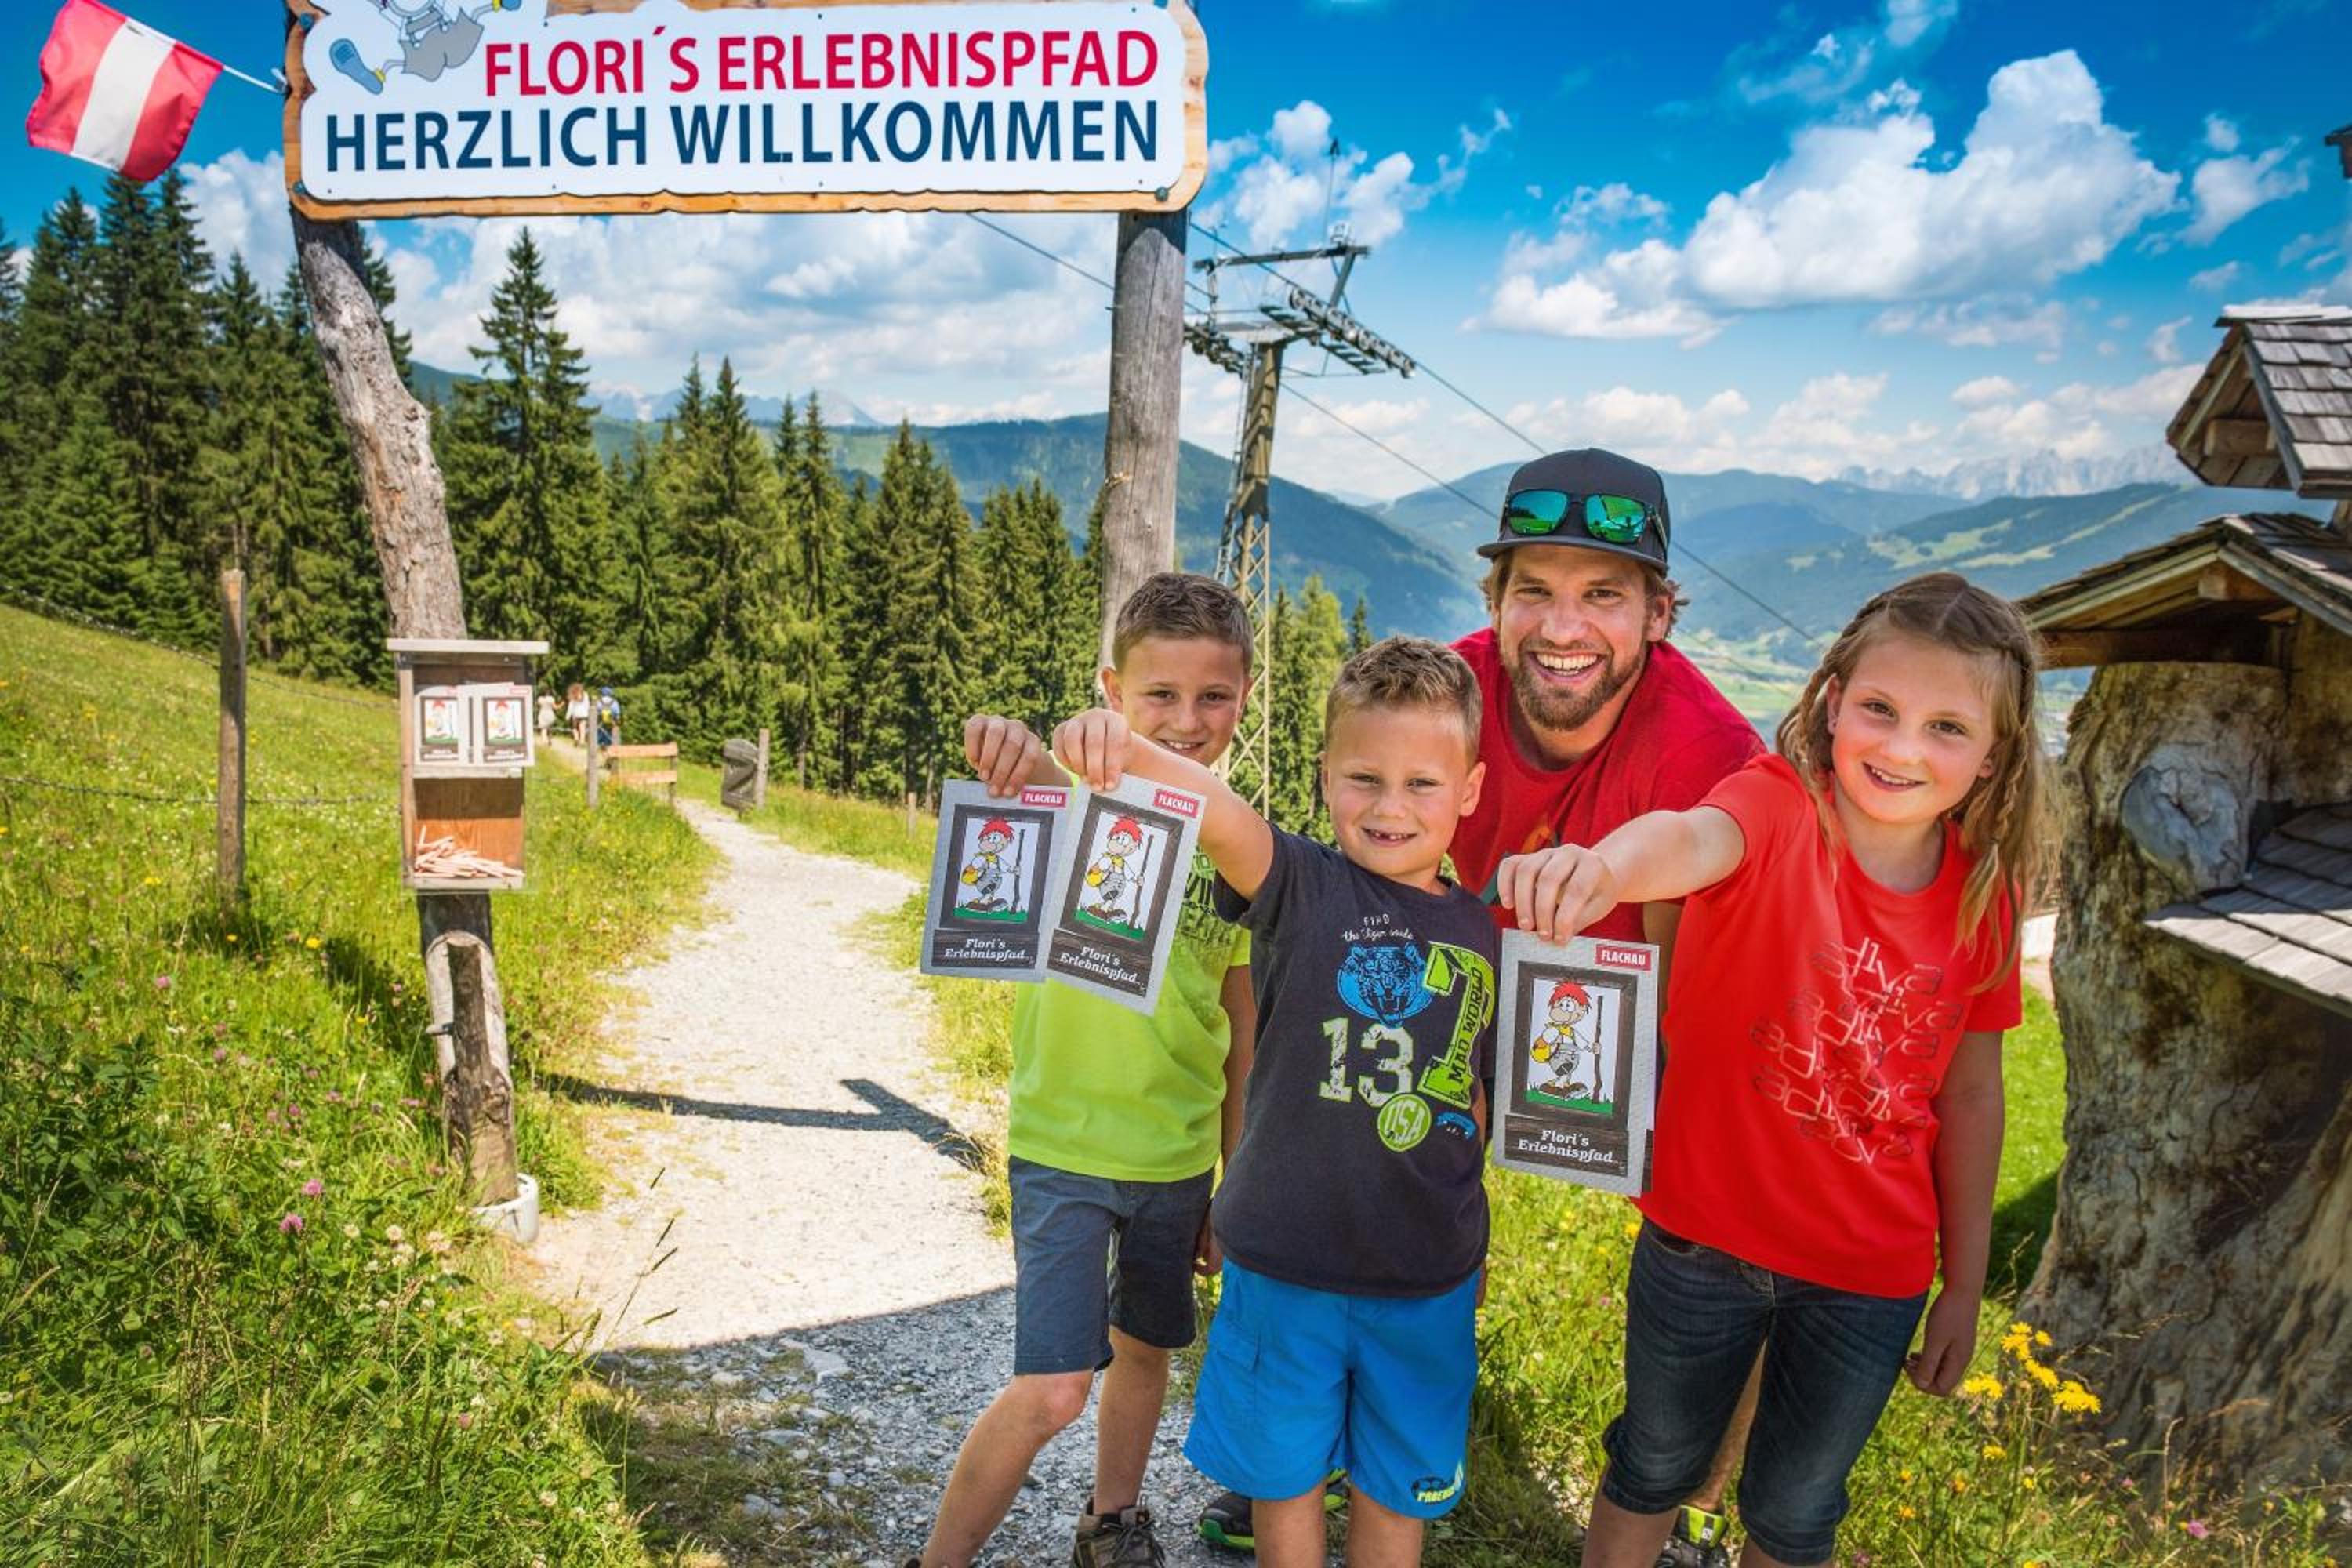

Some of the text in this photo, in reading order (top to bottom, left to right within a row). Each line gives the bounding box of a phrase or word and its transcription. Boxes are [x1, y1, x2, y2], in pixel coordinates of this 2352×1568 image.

[718, 31, 1158, 91] ERLEBNISPFAD
[327, 100, 1157, 172] HERZLICH WILLKOMMEN
[1602, 949, 1646, 964] FLACHAU
[1448, 967, 1483, 1084] MAD WORLD
[1319, 1018, 1413, 1108] 13
